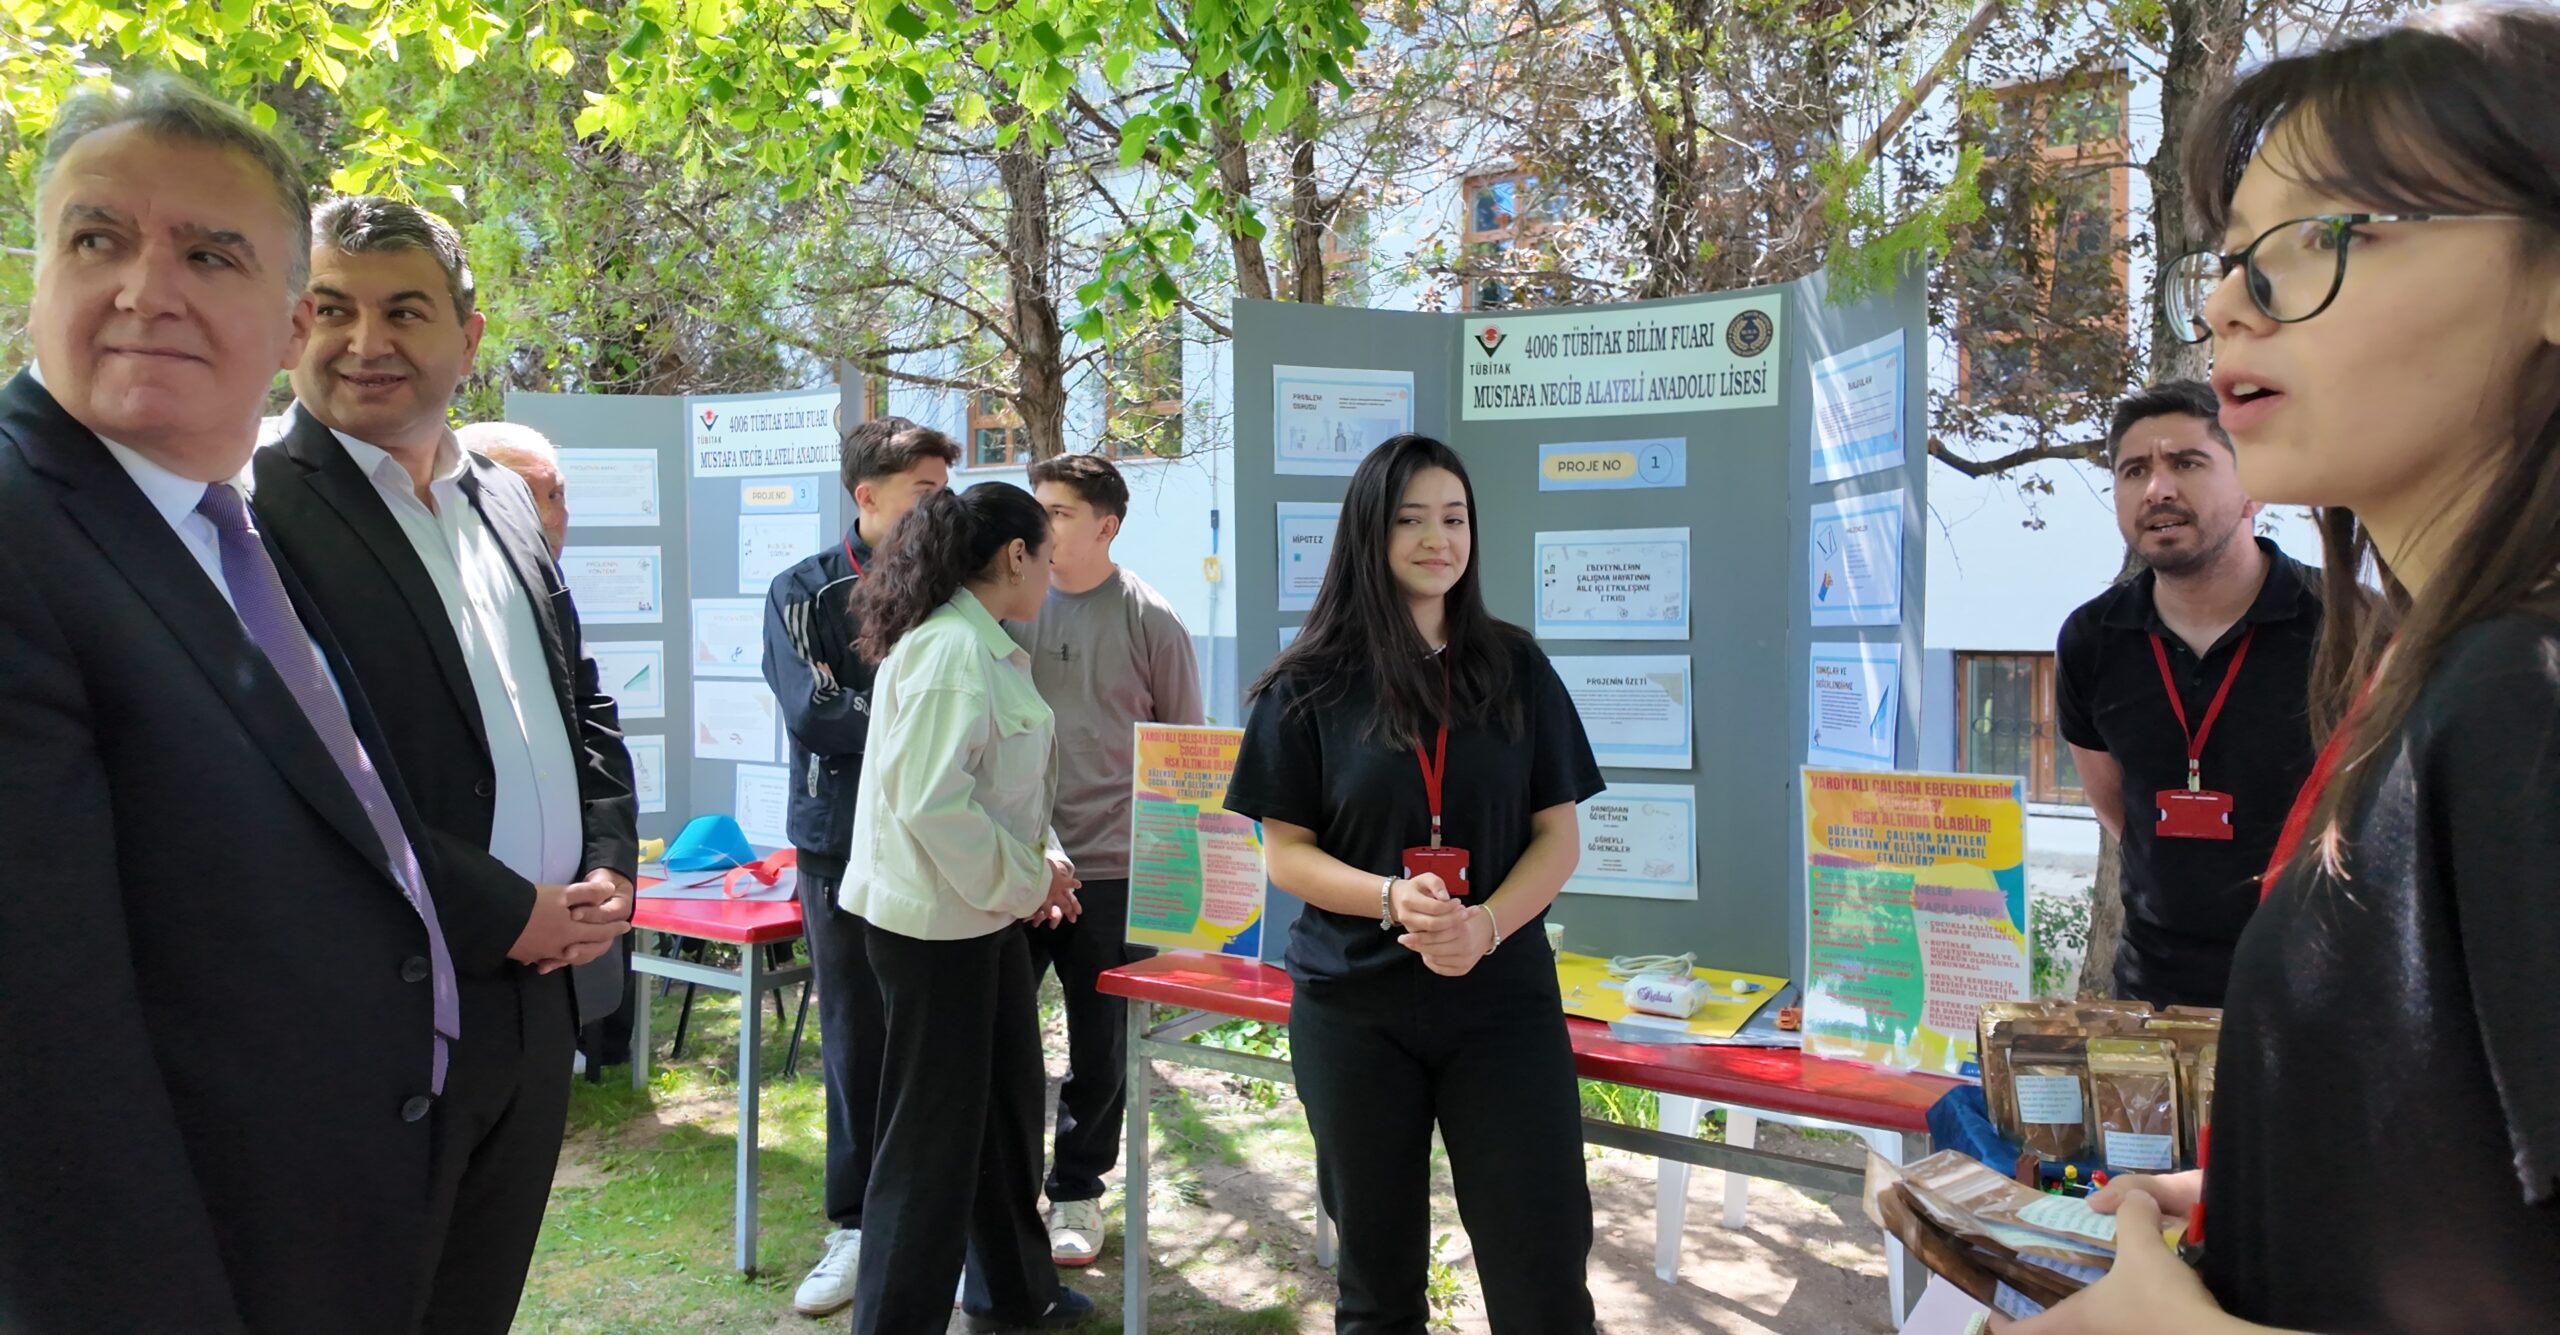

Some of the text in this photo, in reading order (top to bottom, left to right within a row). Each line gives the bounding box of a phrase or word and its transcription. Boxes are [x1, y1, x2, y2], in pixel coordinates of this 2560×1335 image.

[1525, 334, 1557, 359] 4006
[1562, 325, 1622, 358] TÜBİTAK
[1626, 320, 1667, 354] BİLİM
[1671, 323, 1714, 350] FUARI
[1470, 363, 1511, 376] TÜBİTAK
[1473, 361, 1767, 409] MUSTAFA NECİB ALAYELİ ANADOLU LİSESİ
[729, 407, 828, 432] 4006 TÜBİTAK BİLİM FUARI
[700, 451, 737, 468] MUSTAFA
[739, 444, 763, 467] NECİB
[764, 443, 794, 466] ALAYELİ
[796, 445, 829, 464] ANADOLU
[1651, 456, 1660, 469] 1
[1558, 460, 1621, 472] PROJE NO
[752, 491, 787, 500] PROJE NO
[800, 489, 806, 499] 3
[1292, 534, 1324, 544] HİPOTEZ
[1810, 775, 2011, 799] VARDİYALI ÇALIŞAN EBEVEYNLERİN
[1853, 808, 1991, 833] RİSK ALTINDA OLABİLİR!
[1827, 824, 1987, 847] DÜZENSİZ ÇALIŞMA SAATLERİ
[1877, 852, 1935, 866] ETKİLİYOR?
[1956, 847, 1987, 859] NASIL
